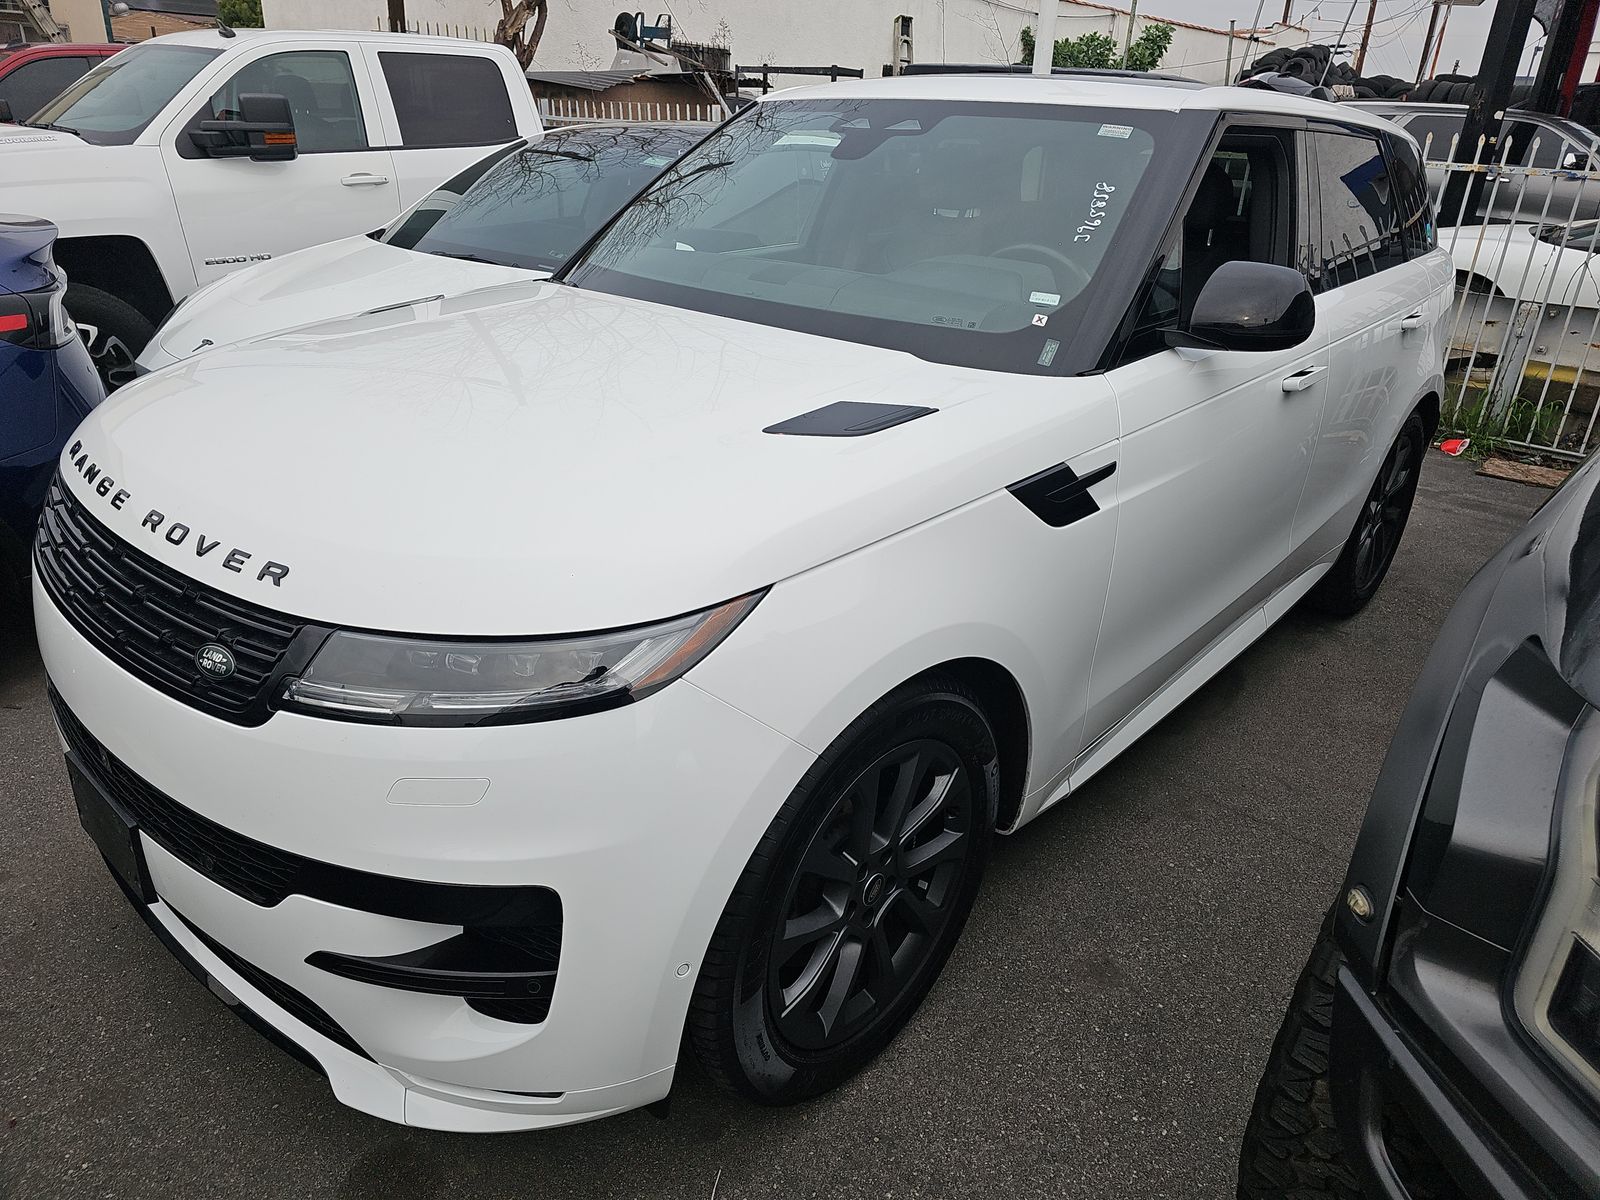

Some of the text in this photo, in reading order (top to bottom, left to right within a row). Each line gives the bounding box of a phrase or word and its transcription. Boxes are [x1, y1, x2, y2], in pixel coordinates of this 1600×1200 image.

[249, 253, 272, 262] HD
[69, 439, 290, 587] RANGE ROVER
[202, 648, 224, 663] LAND
[201, 657, 227, 675] ROVER
